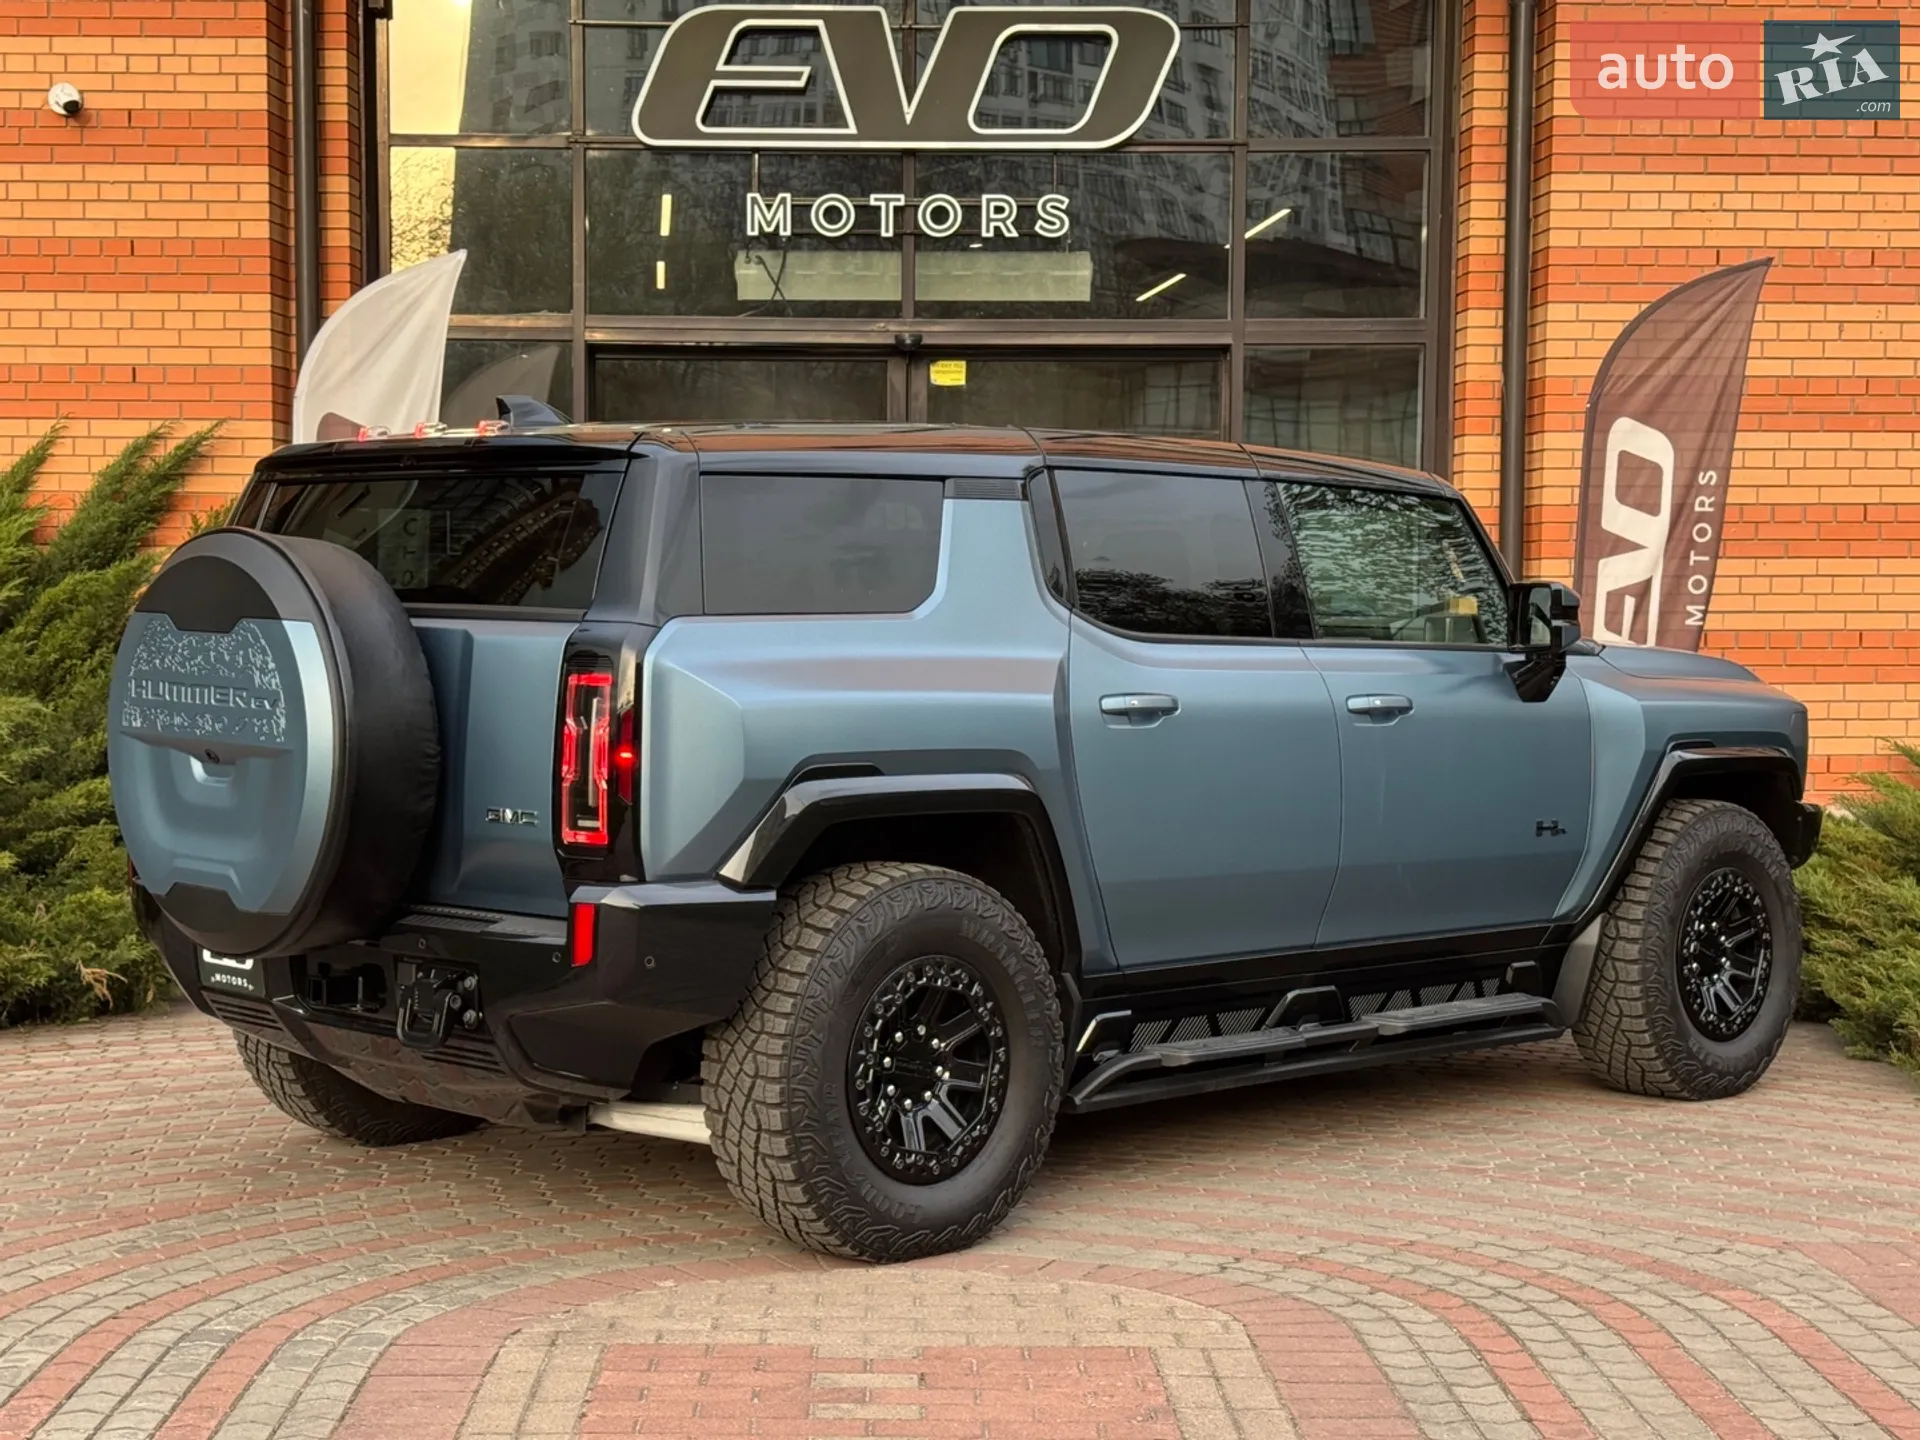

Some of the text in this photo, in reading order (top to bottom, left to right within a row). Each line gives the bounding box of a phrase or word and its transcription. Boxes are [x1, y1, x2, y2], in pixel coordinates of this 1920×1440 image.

[631, 4, 1181, 149] EVO
[745, 192, 1070, 238] MOTORS
[1592, 416, 1675, 648] EVO
[1684, 469, 1718, 627] MOTORS
[129, 678, 249, 710] HUMMER
[485, 806, 539, 827] GMC
[213, 972, 249, 989] MOTORS
